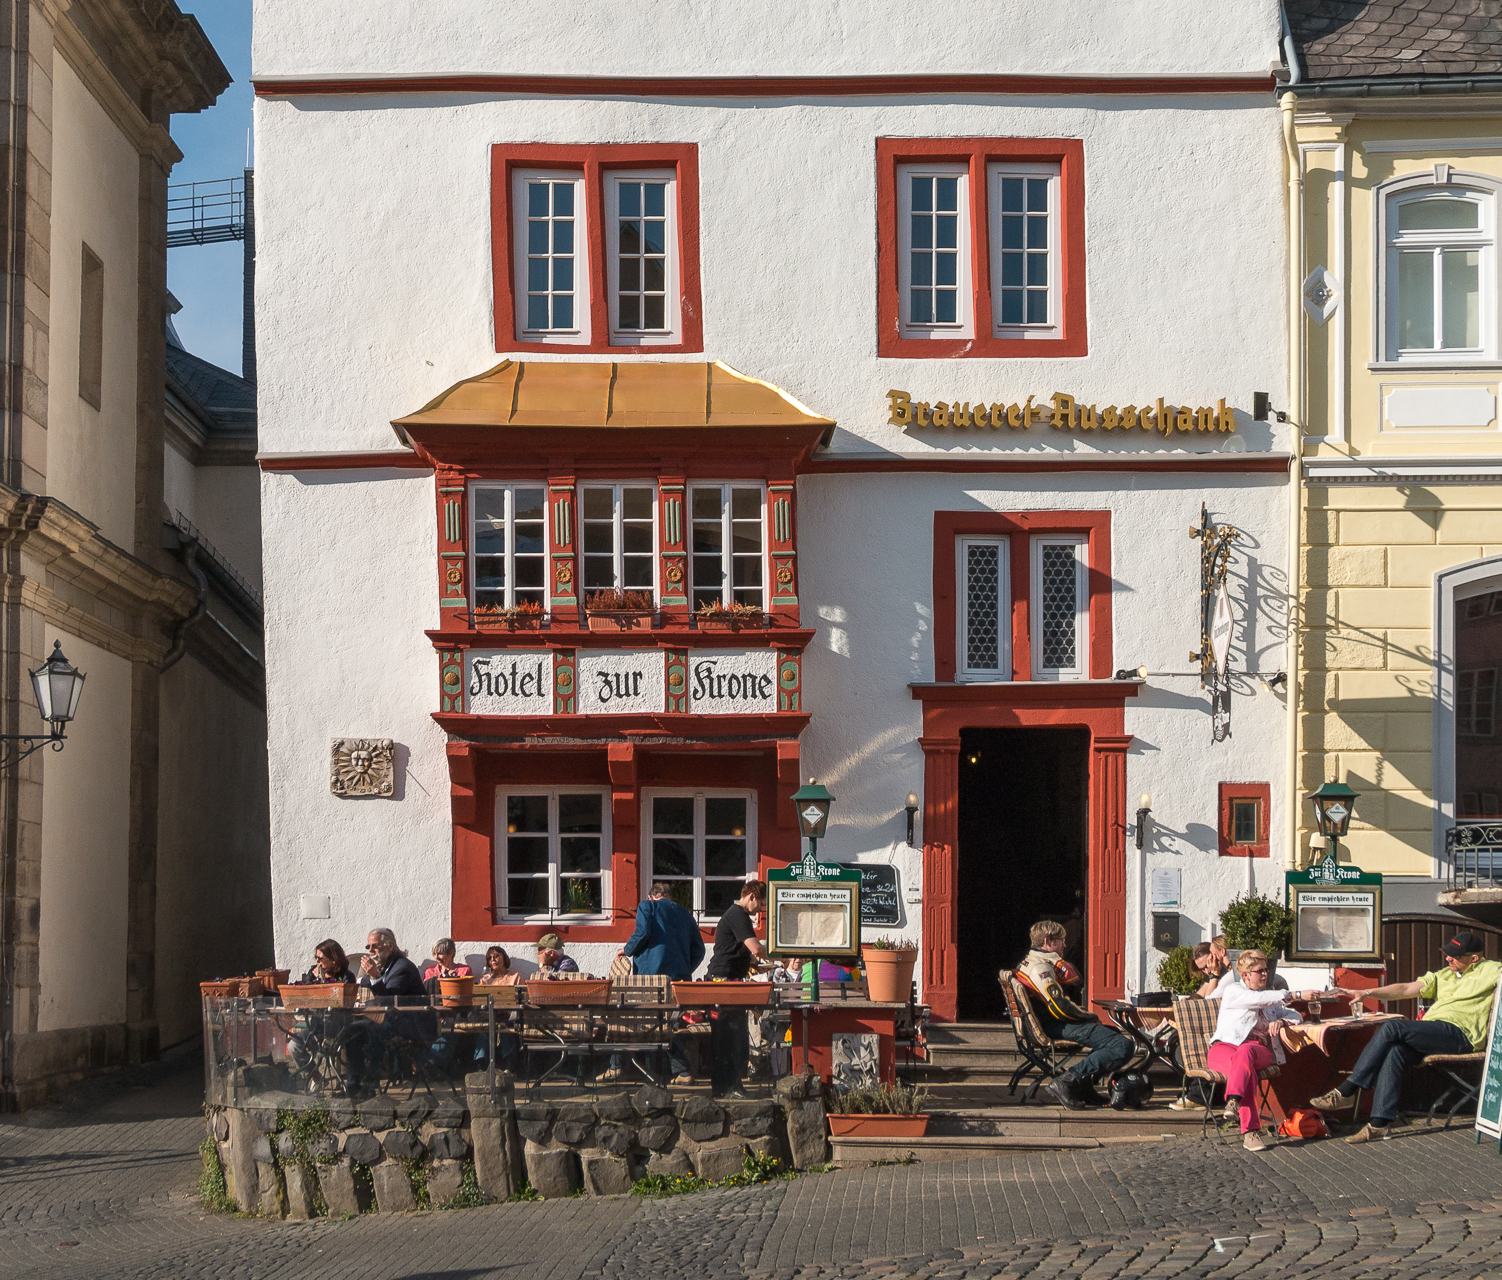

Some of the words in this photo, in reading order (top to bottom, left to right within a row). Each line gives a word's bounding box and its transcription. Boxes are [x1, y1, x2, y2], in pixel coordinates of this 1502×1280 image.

[469, 659, 546, 699] Hotel
[596, 668, 643, 704] zur
[691, 659, 773, 702] Krone
[817, 865, 840, 875] Krone
[1336, 868, 1360, 879] Krone
